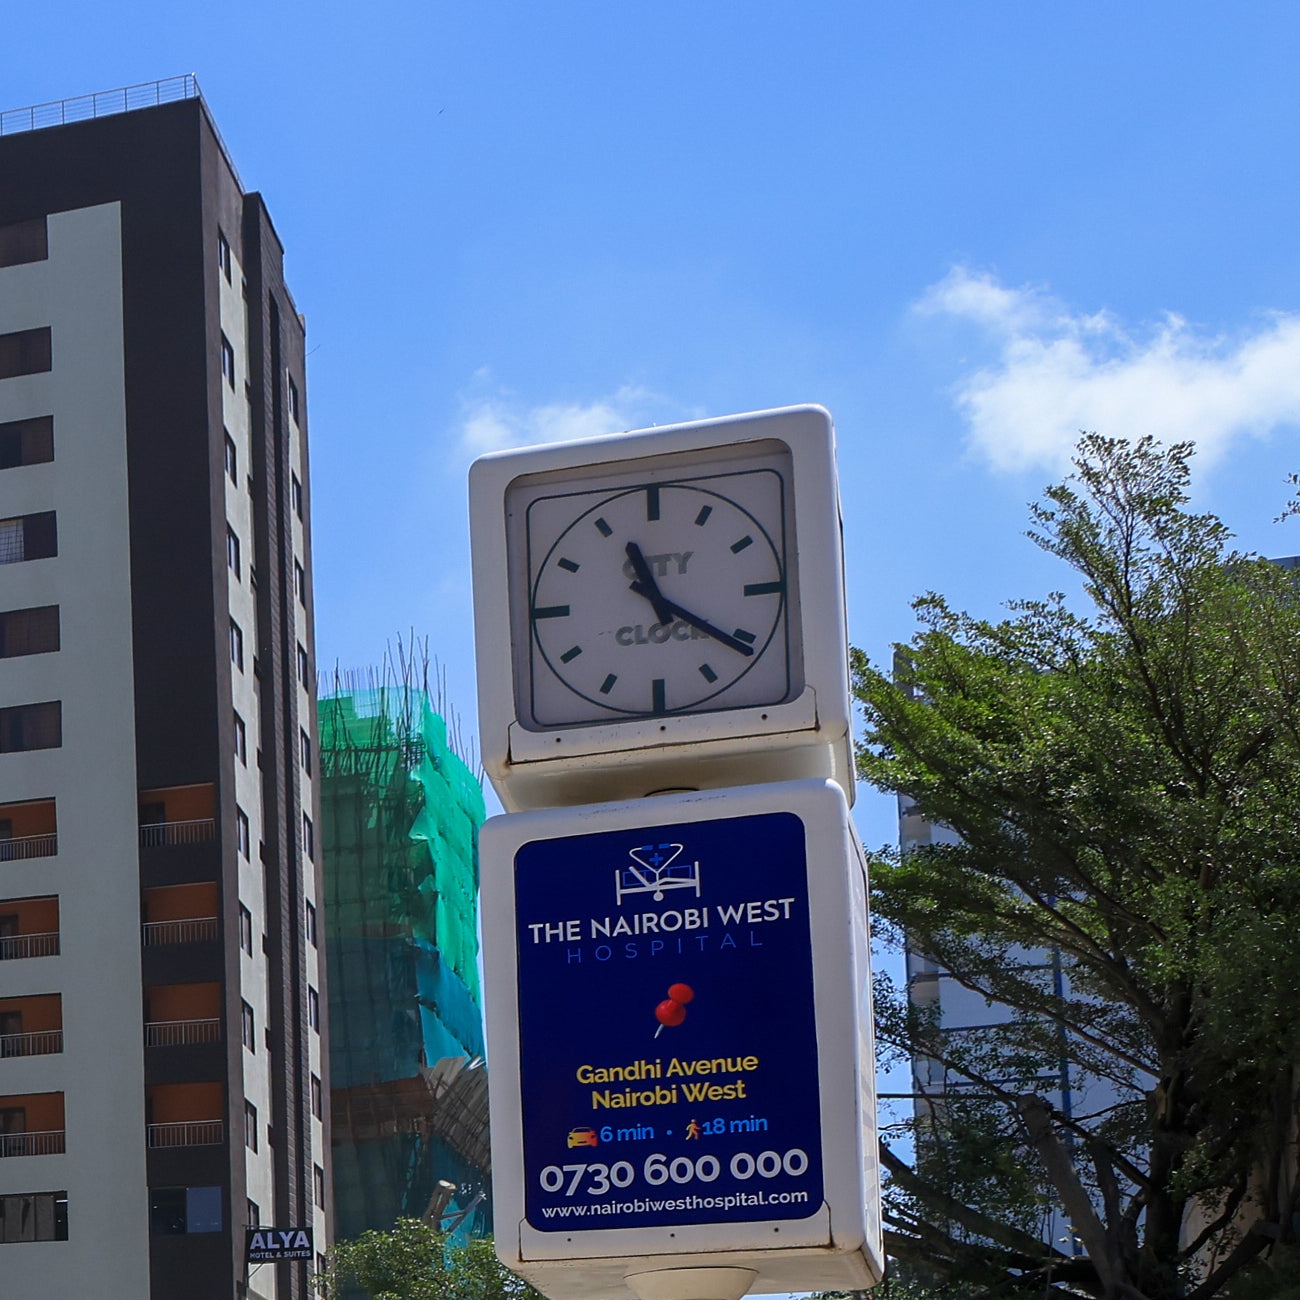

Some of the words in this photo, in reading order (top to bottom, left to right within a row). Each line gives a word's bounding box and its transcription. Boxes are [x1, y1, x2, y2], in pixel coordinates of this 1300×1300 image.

[528, 920, 582, 944] THE
[590, 907, 709, 939] NAIROBI
[717, 898, 795, 926] WEST
[567, 931, 763, 964] HOSPITAL
[576, 1059, 662, 1084] Gandhi
[666, 1055, 759, 1077] Avenue
[592, 1084, 678, 1110] Nairobi
[681, 1080, 747, 1102] West
[600, 1126, 613, 1142] 6
[617, 1123, 654, 1142] min
[702, 1117, 726, 1135] 18
[730, 1115, 768, 1133] min
[539, 1160, 635, 1197] 0730
[644, 1153, 721, 1186] 600
[729, 1148, 809, 1180] 000
[542, 1191, 808, 1218] www.nairobiwesthospital.com
[250, 1231, 310, 1250] ALYA
[283, 1250, 311, 1258] SUITES
